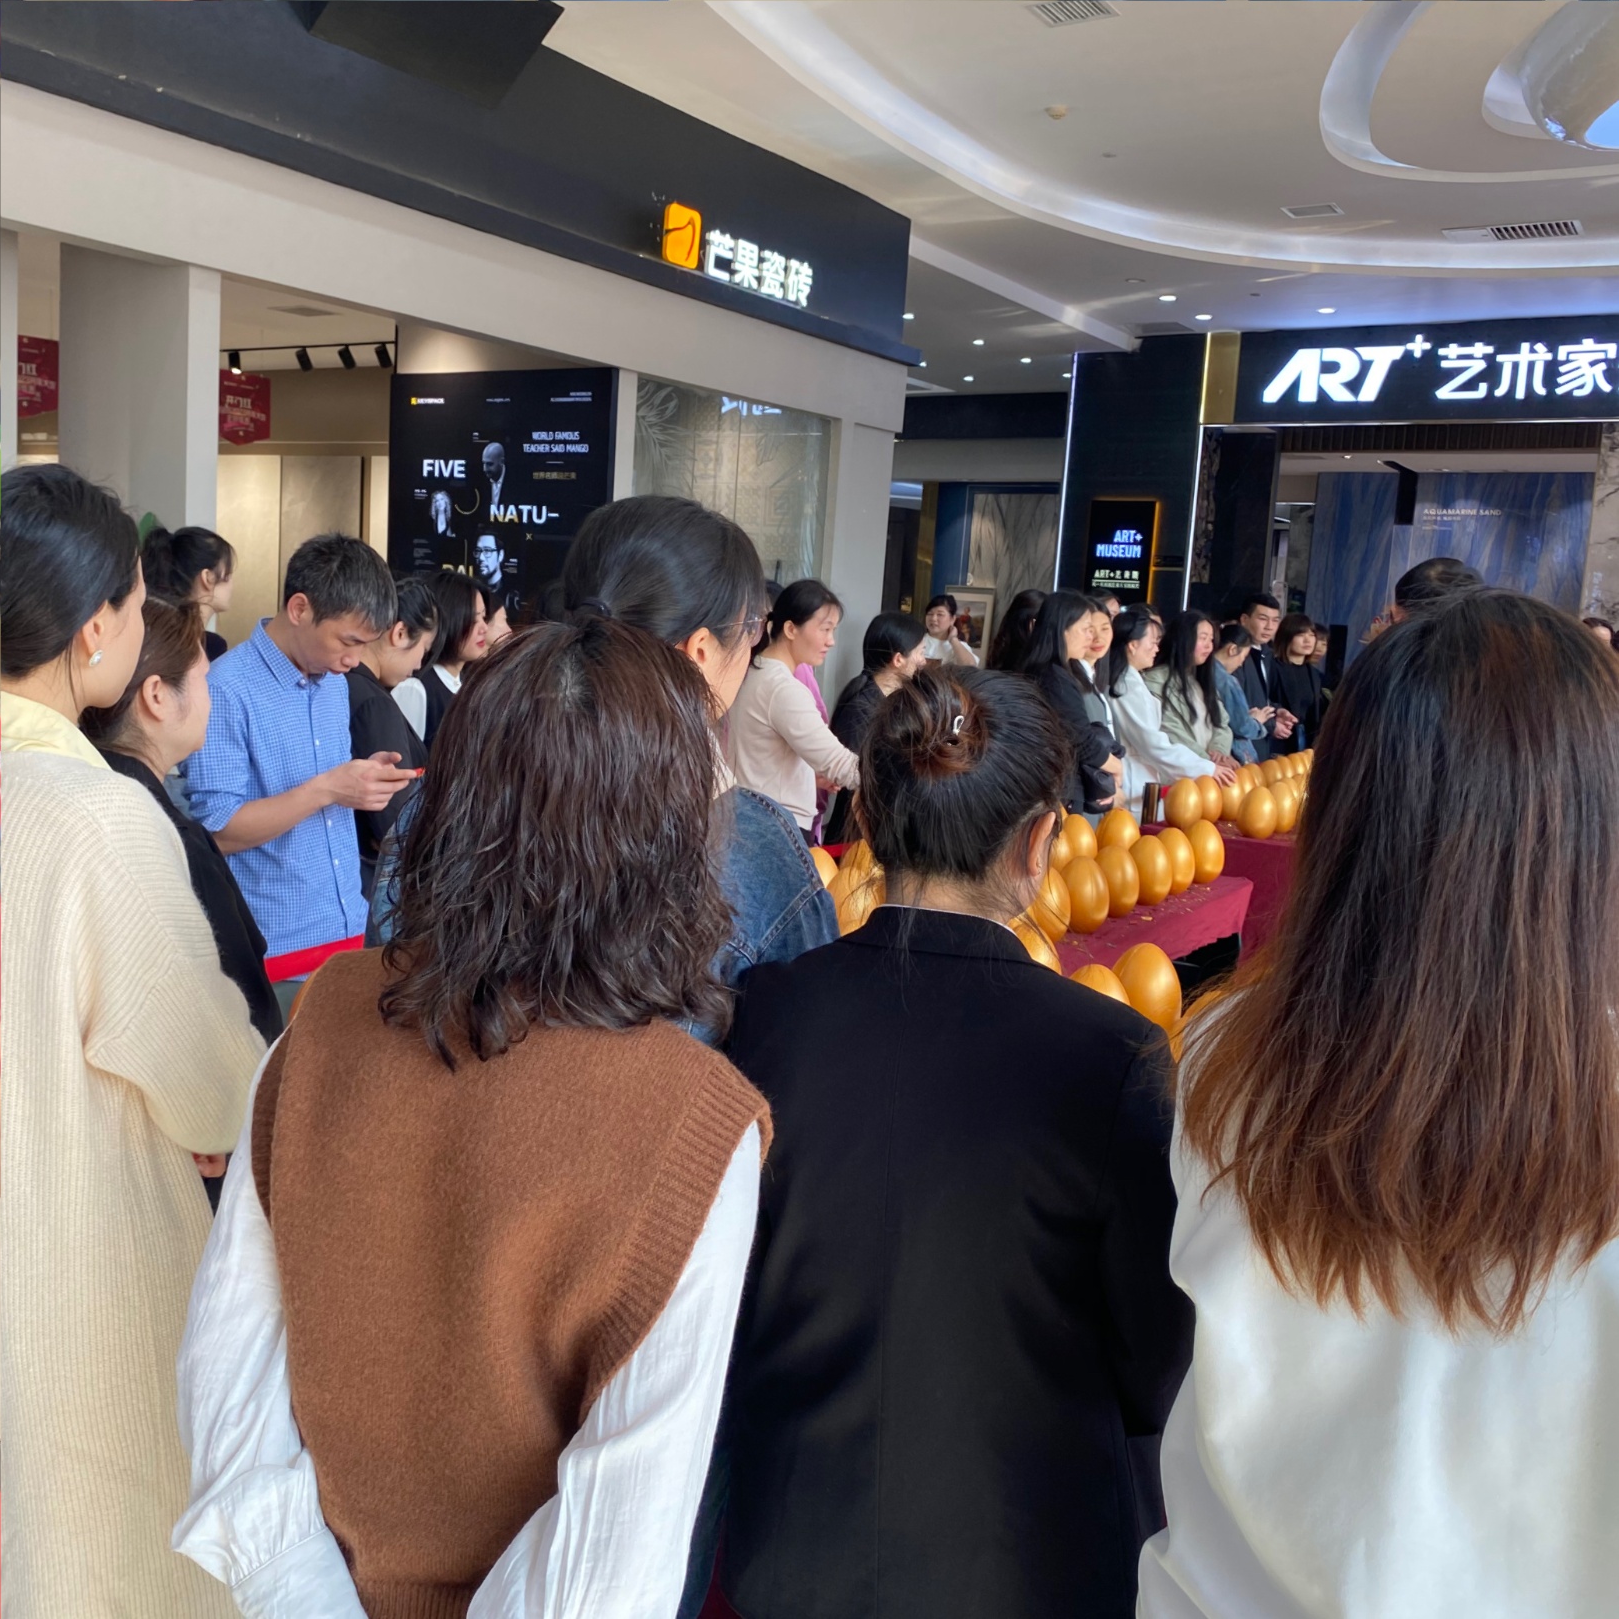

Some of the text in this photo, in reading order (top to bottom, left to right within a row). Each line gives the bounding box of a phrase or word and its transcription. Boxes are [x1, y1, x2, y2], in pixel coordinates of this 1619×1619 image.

[704, 230, 814, 308] 芒果瓷砖
[1434, 337, 1619, 402] 艺术家
[531, 431, 581, 441] WORLD FAMOUS
[522, 443, 590, 454] TEACHER SAID MANGO
[422, 458, 467, 479] FIVE
[1423, 508, 1502, 517] AQUAMARINE SAND
[1095, 543, 1142, 559] MUSEUM
